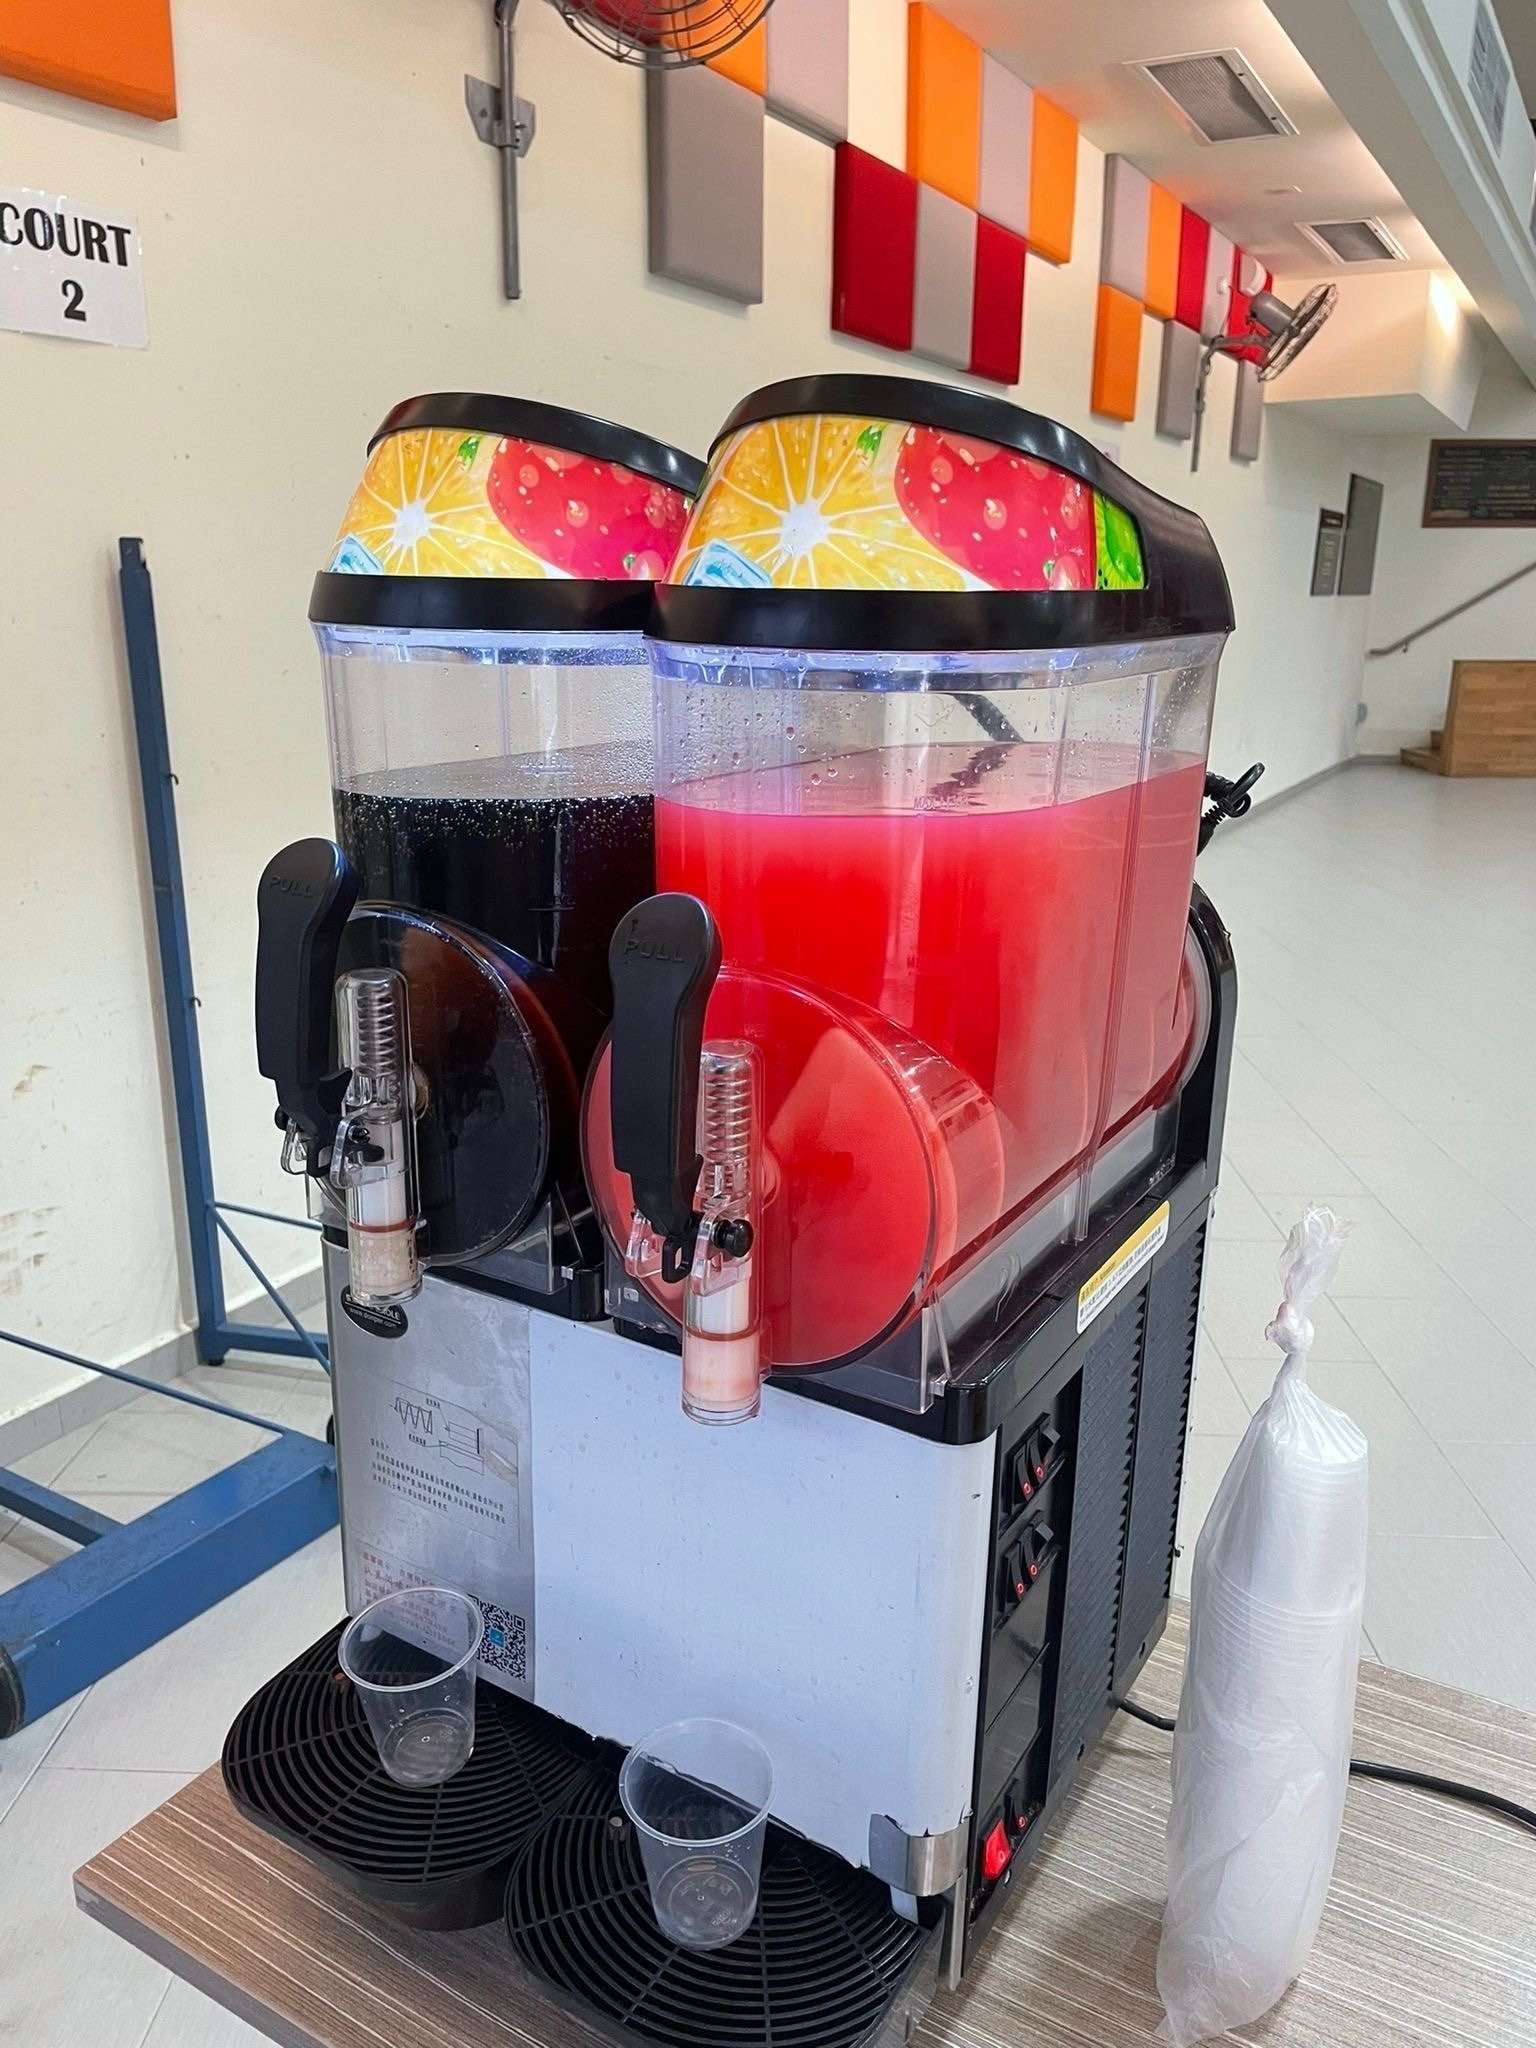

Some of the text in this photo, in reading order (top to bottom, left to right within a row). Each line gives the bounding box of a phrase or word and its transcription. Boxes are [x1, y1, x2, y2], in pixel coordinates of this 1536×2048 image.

[0, 202, 131, 267] COURT
[61, 279, 87, 322] 2
[269, 874, 314, 897] PULL
[624, 939, 686, 963] PULL
